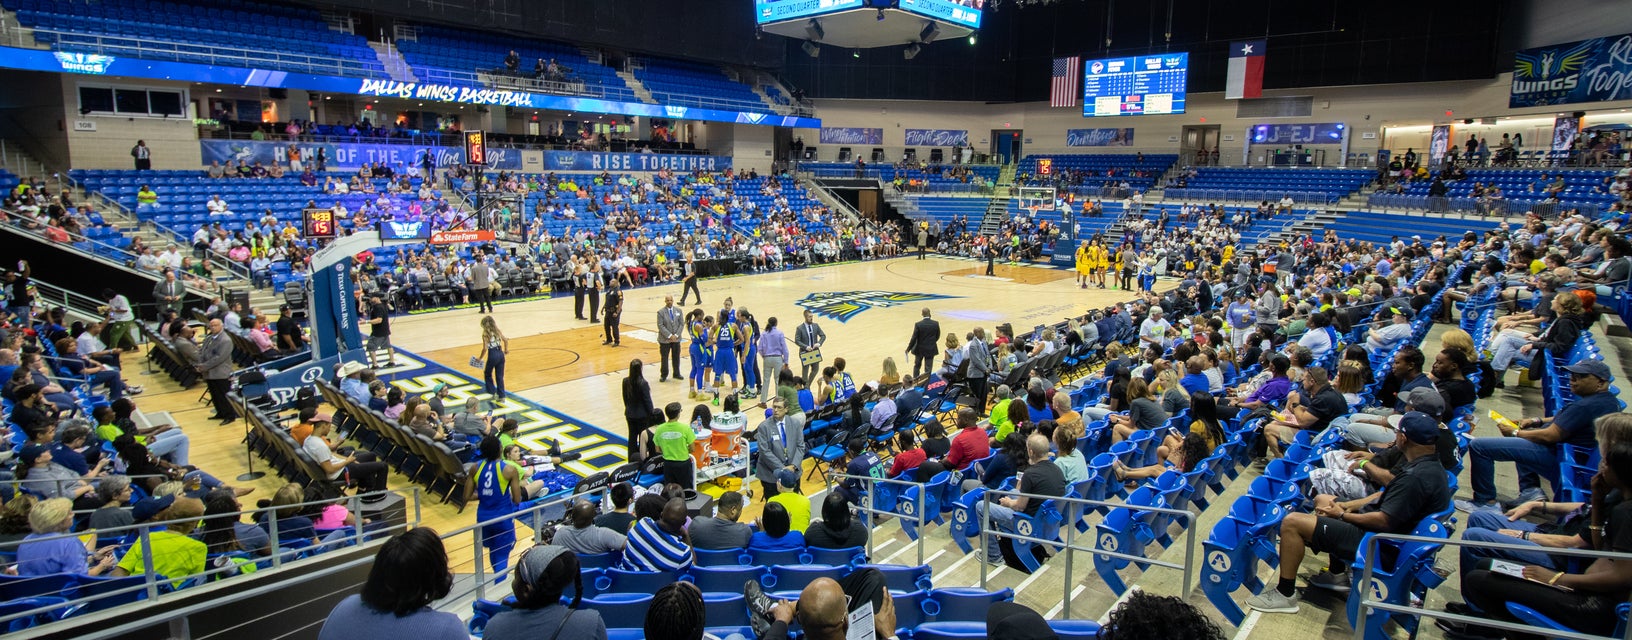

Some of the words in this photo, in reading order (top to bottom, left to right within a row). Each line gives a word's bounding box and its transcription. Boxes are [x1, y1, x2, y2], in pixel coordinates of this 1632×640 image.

[358, 78, 416, 98] DALLAS
[416, 84, 458, 102] WINGS
[458, 87, 533, 107] BASKETBALL
[1512, 74, 1579, 94] WINGS
[336, 148, 357, 164] OF
[366, 149, 401, 165] THE
[414, 148, 460, 168] Dllas
[592, 154, 631, 170] RISE
[640, 155, 716, 171] TOGETHER
[312, 212, 331, 222] 4:33
[315, 222, 328, 234] 15
[720, 327, 730, 337] 25
[484, 471, 493, 488] 3
